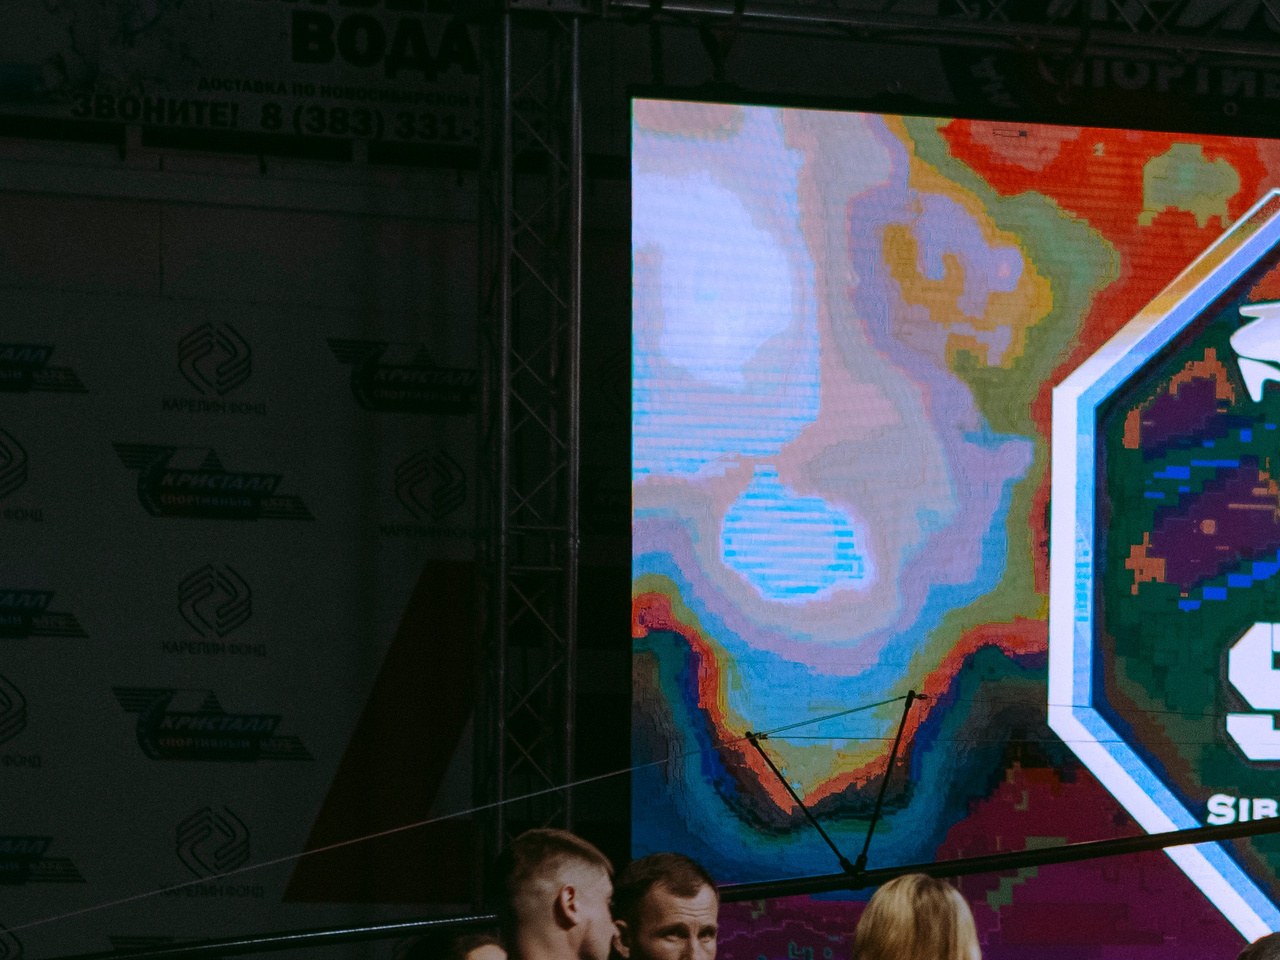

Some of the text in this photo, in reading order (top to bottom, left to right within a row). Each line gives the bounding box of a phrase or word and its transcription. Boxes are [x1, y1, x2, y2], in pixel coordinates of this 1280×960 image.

[291, 10, 481, 81] ВОДА
[198, 76, 287, 96] ДОСТАВКА
[291, 82, 316, 97] ПО
[320, 84, 471, 107] НОВОСИБИРСКОЙ
[71, 93, 239, 128] ЗВОНИТЕ!
[260, 102, 284, 130] 8
[292, 106, 386, 140] (383)
[162, 398, 267, 417] КАРЕЛИН ФОНД
[161, 472, 278, 491] КРИСТАЛЛ
[160, 493, 253, 507] СПОРТИВНЫЙ
[161, 640, 267, 658] КАРЕЛИН ФОНД
[160, 715, 277, 732] КРИСТАЛЛ
[158, 736, 251, 750] СПОРТИВНЫЙ
